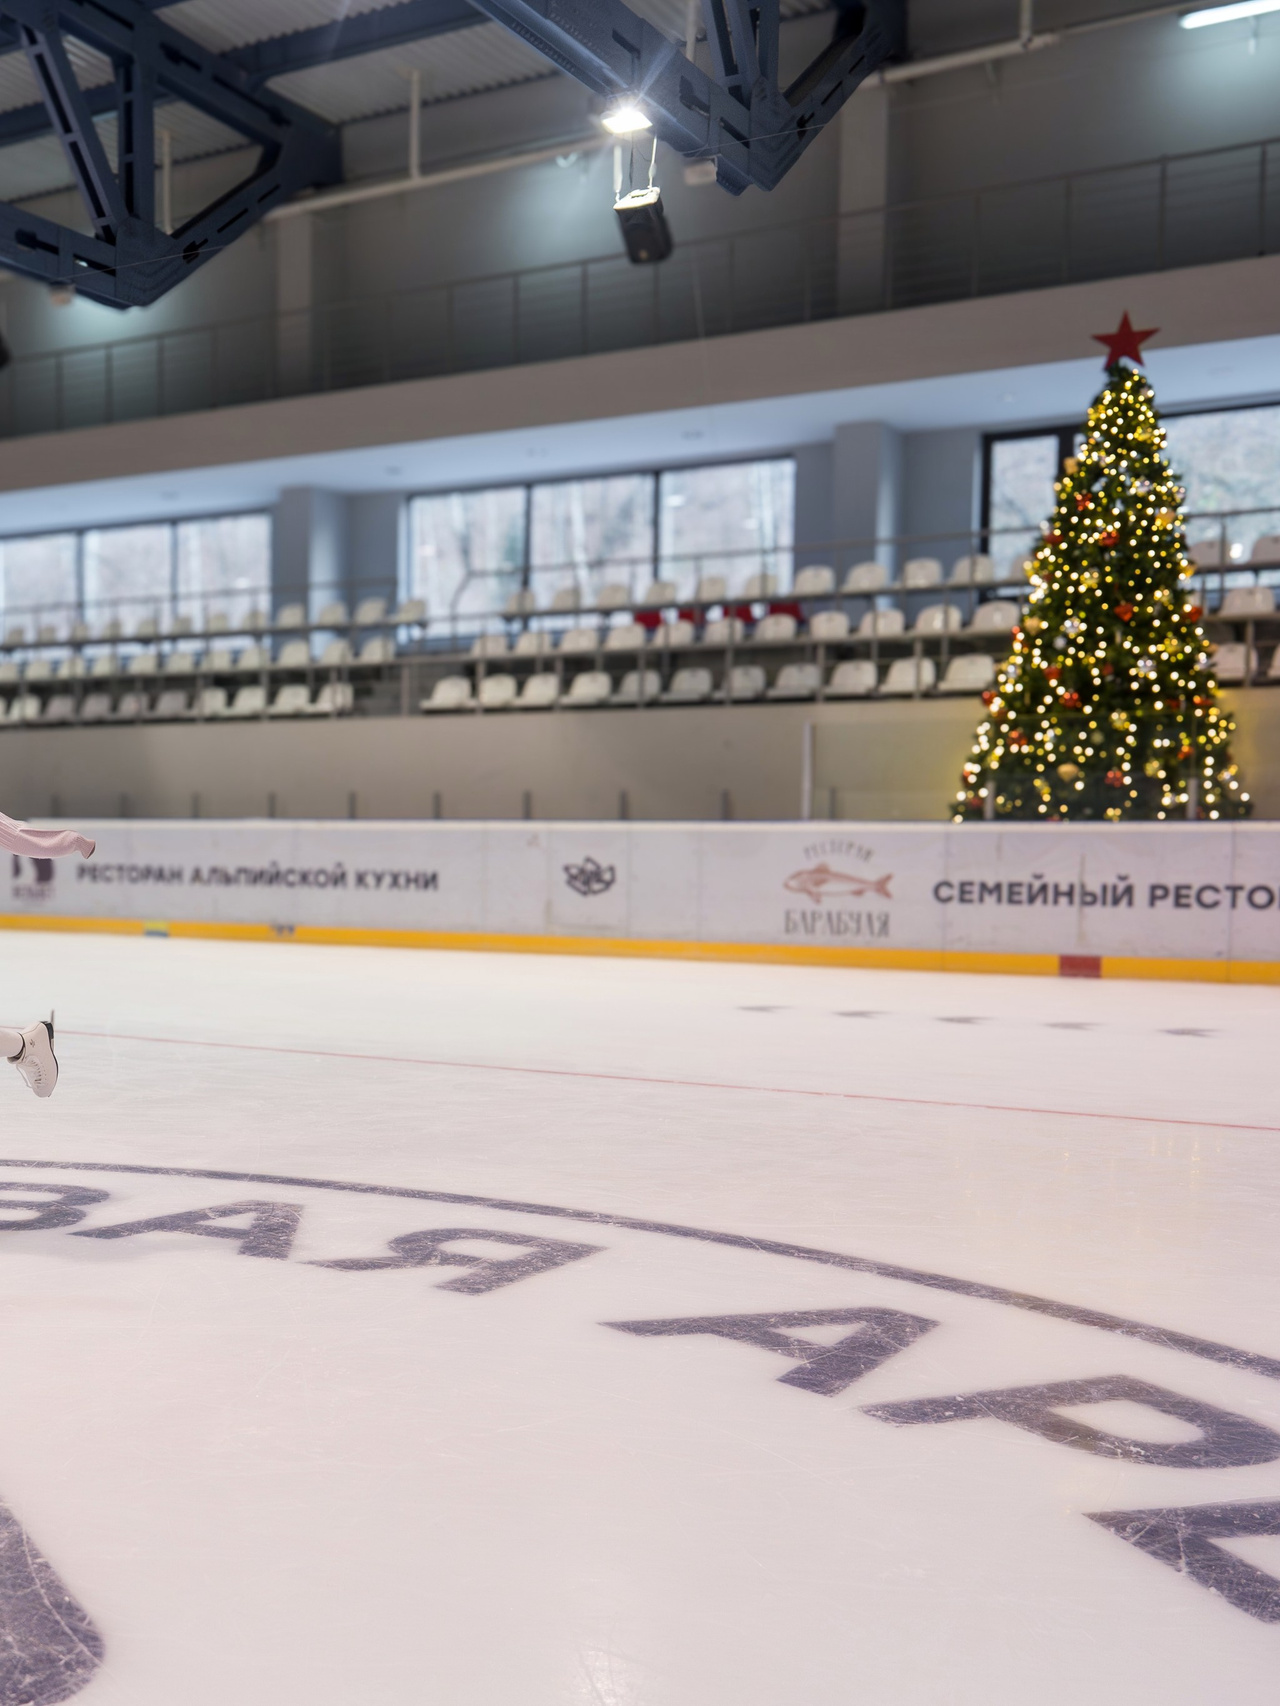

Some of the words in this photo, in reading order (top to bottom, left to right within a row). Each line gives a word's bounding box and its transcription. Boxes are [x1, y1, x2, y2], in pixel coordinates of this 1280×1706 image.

[76, 863, 184, 885] РЕСТОРАН
[190, 861, 348, 890] АЛЬПИЙСКОЙ
[355, 872, 439, 892] КУХНИ
[933, 874, 1135, 909] СЕМЕЙНЫЙ
[1149, 884, 1280, 911] РЕСТО
